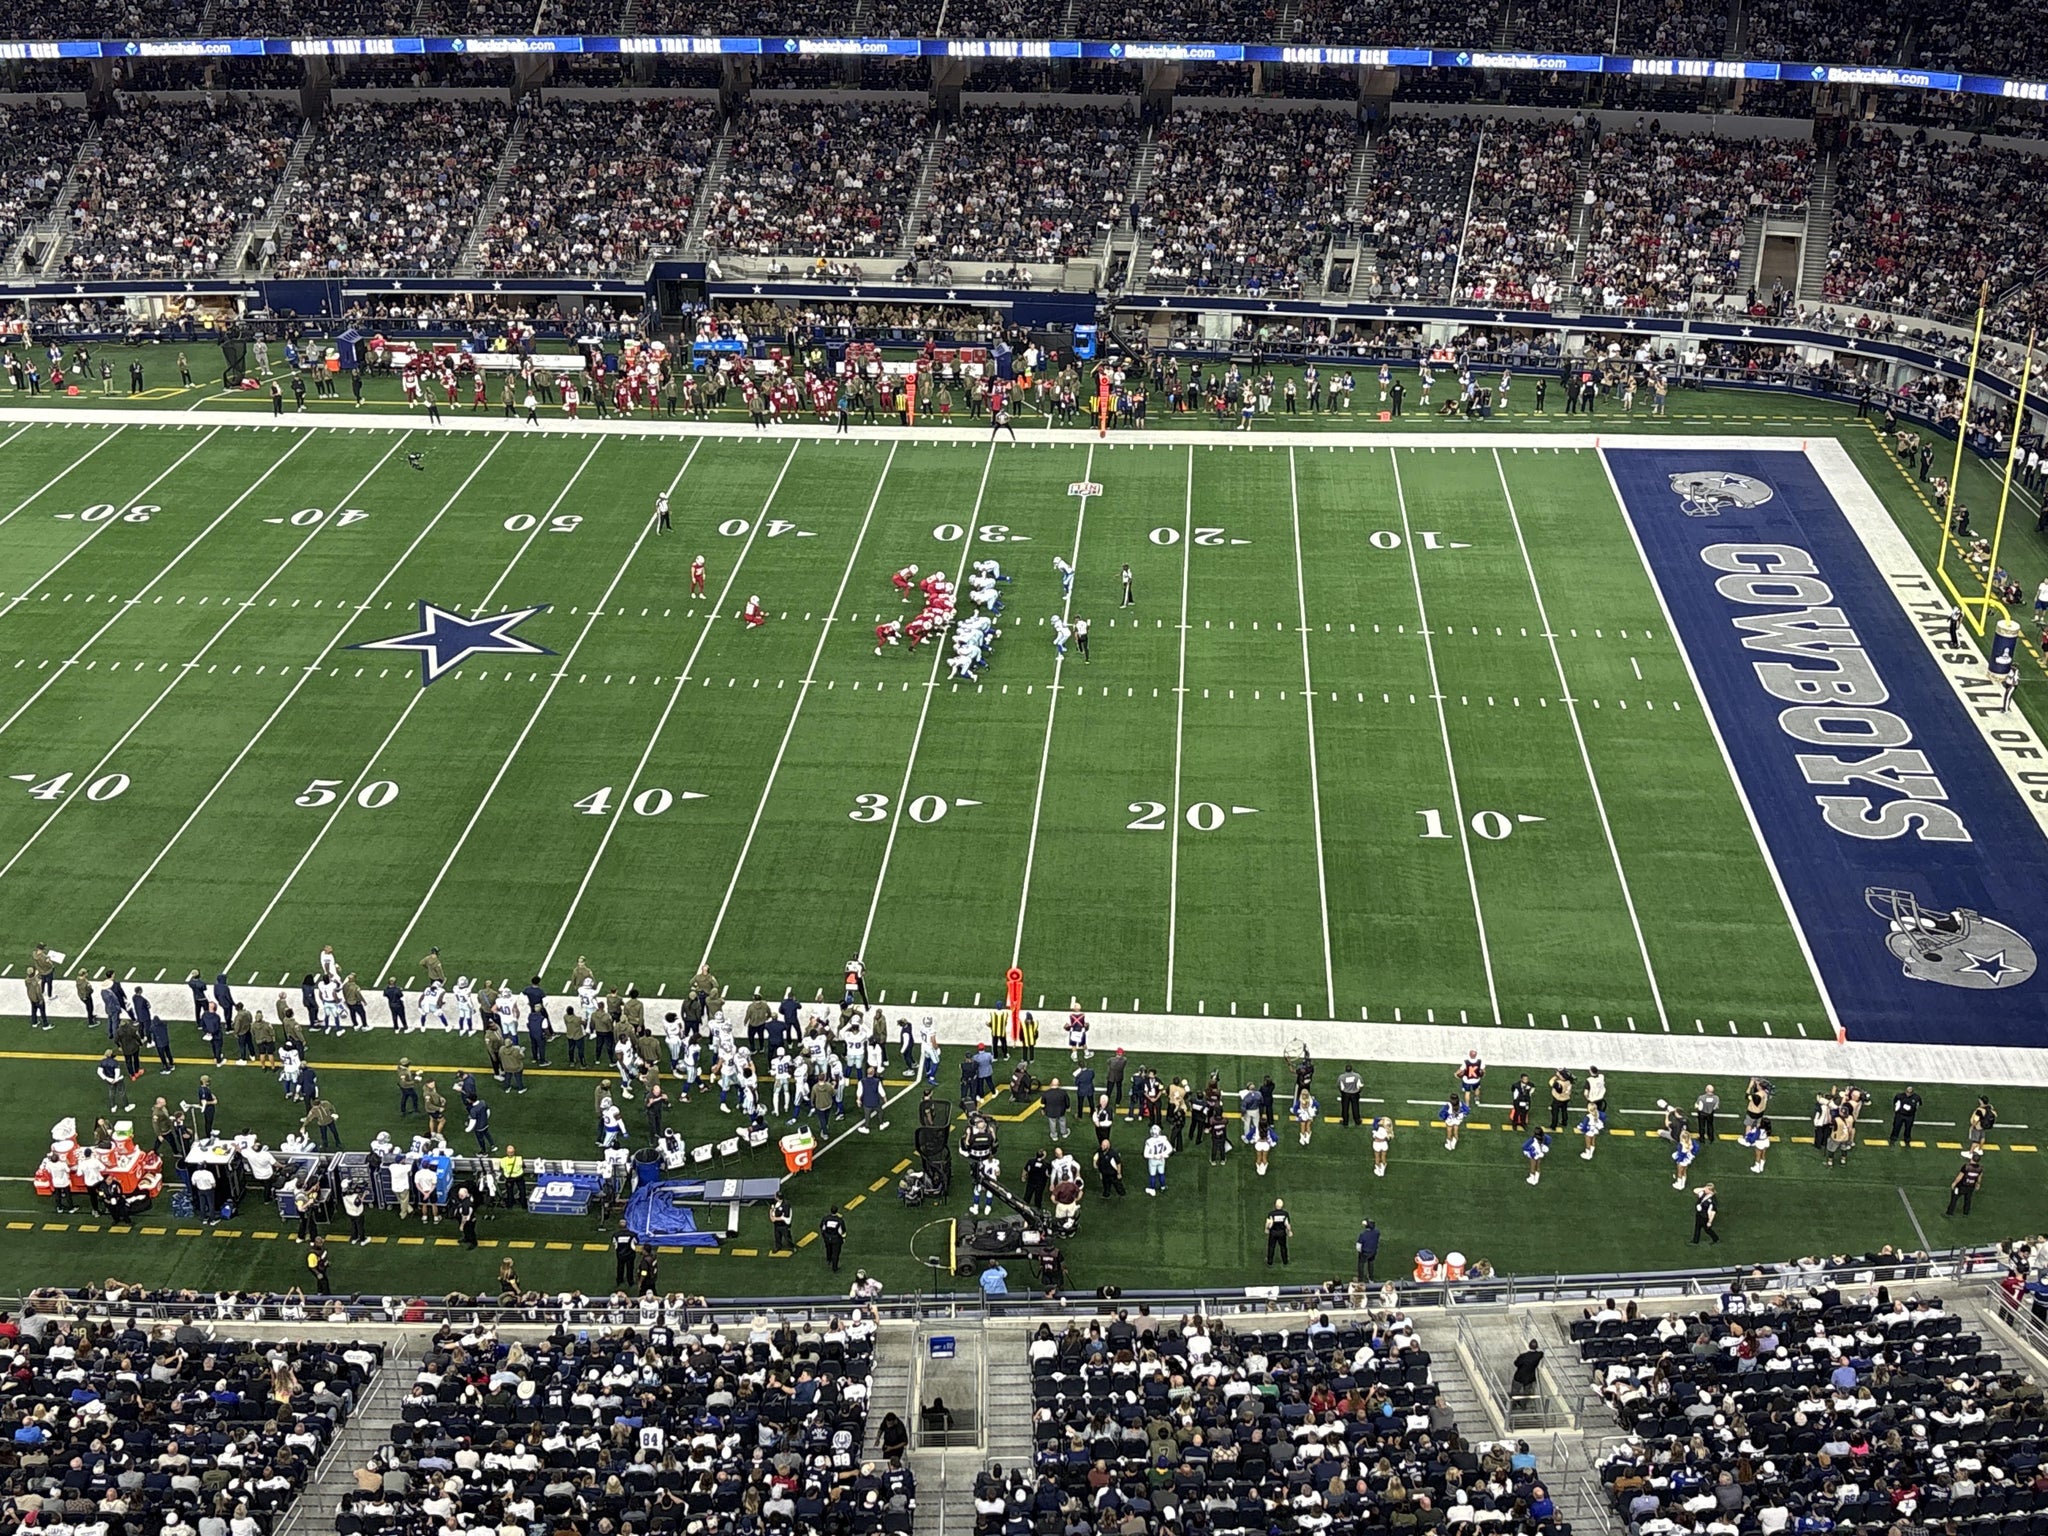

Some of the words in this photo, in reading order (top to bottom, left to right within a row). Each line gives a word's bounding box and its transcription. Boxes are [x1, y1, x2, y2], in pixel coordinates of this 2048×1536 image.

[140, 41, 231, 56] Blockchain.com
[291, 41, 329, 55] BLOCK
[332, 40, 361, 54] THAT
[466, 39, 555, 53] Blockchain.com
[620, 39, 657, 53] BLOCK
[660, 39, 689, 53] THAT
[799, 39, 888, 54] Blockchain.com
[948, 41, 985, 56] BLOCK
[989, 42, 1017, 56] THAT
[1124, 44, 1215, 59] Blockchain.com
[1283, 48, 1320, 63] BLOCK
[1325, 49, 1355, 64] THAT
[1472, 53, 1567, 69] Blockchain.com
[1632, 59, 1672, 75] BLOCK
[1678, 60, 1710, 76] THAT
[1828, 67, 1930, 86] Blockchain.com
[2003, 81, 2047, 100] BLOCK
[81, 505, 161, 526] 30
[291, 509, 368, 526] 40
[504, 515, 583, 531] 50
[719, 520, 795, 537] 40
[934, 525, 1009, 542] 30
[1150, 528, 1224, 545] 20
[1370, 532, 1443, 549] 10
[1890, 573, 1931, 592] IT
[1909, 600, 1978, 666] TAKES
[1700, 543, 1973, 842] COWBOYS
[1954, 675, 2012, 718] ALL
[1990, 730, 2043, 759] OF
[29, 773, 129, 805] 40
[295, 780, 398, 807] 50
[574, 787, 672, 815] 40
[849, 794, 947, 822] 30
[1127, 802, 1224, 830] 20
[1416, 810, 1511, 839] 10
[778, 1062, 790, 1074] 88
[1468, 1066, 1478, 1077] K
[1153, 1143, 1164, 1155] 17
[794, 1151, 809, 1166] G
[643, 1433, 658, 1446] 84
